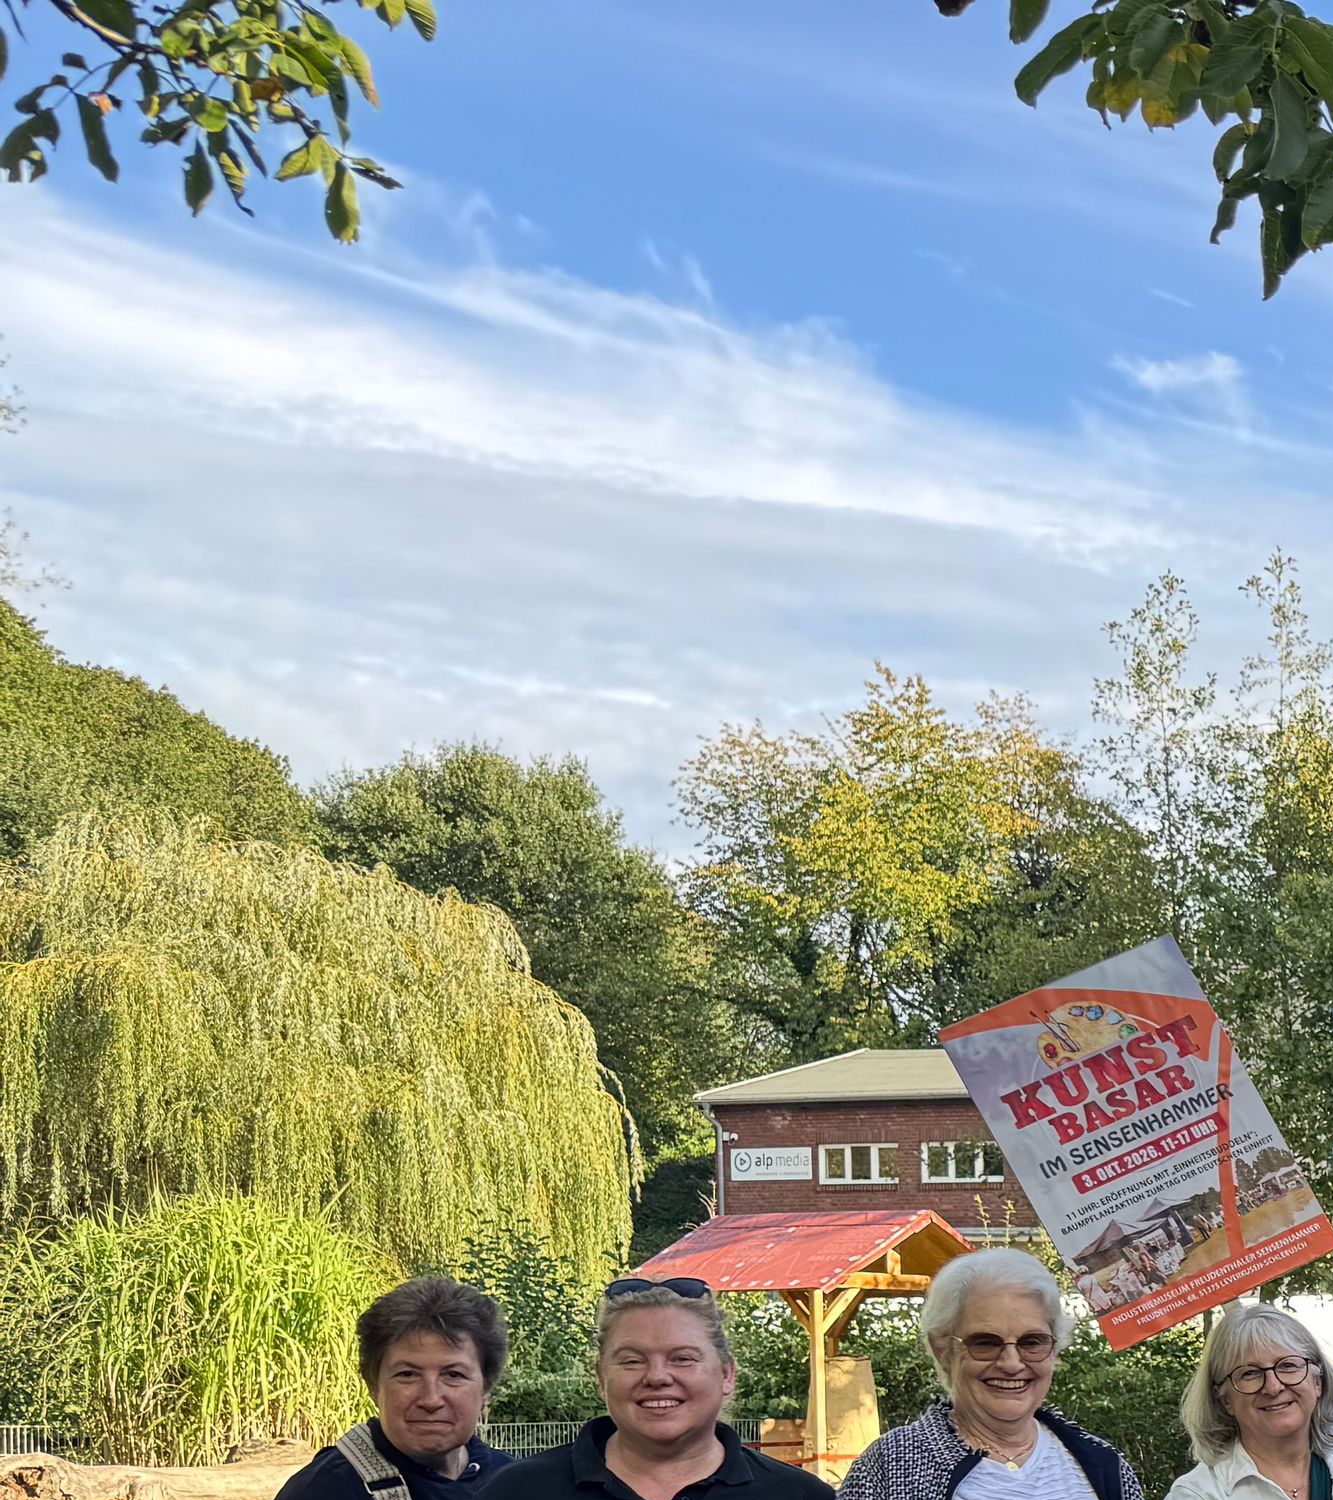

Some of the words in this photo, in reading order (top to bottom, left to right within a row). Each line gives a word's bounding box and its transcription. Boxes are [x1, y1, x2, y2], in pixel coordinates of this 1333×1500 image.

[1000, 1015, 1200, 1129] KUNST
[1048, 1065, 1195, 1145] BASAR
[755, 1153, 772, 1170] alp
[776, 1153, 809, 1166] media
[1039, 1156, 1068, 1180] IM
[1072, 1083, 1234, 1165] SENSENHAMMER
[1081, 1174, 1098, 1188] 3.
[1096, 1161, 1125, 1182] OKT.
[1124, 1146, 1162, 1170] 2026,
[1160, 1130, 1190, 1152] 11-17
[1191, 1118, 1218, 1140] UHR
[1061, 1193, 1146, 1235] BAUMPFLANZAKTION
[1146, 1184, 1165, 1198] ZUM
[1164, 1176, 1180, 1188] TAG
[1180, 1169, 1198, 1181] DER
[1197, 1149, 1243, 1174] DEUTSCHEN
[1243, 1134, 1273, 1153] EINHEIT
[1066, 1212, 1077, 1220] 11
[1078, 1202, 1101, 1216] UHR:
[1100, 1178, 1153, 1206] ERÖFFNUNG
[1153, 1169, 1170, 1182] MIT
[1112, 1284, 1190, 1325] INDUSTRIEMUSEUM
[1190, 1253, 1257, 1289] FREUDENTHALER
[1256, 1223, 1321, 1258] SENSENHAMMER
